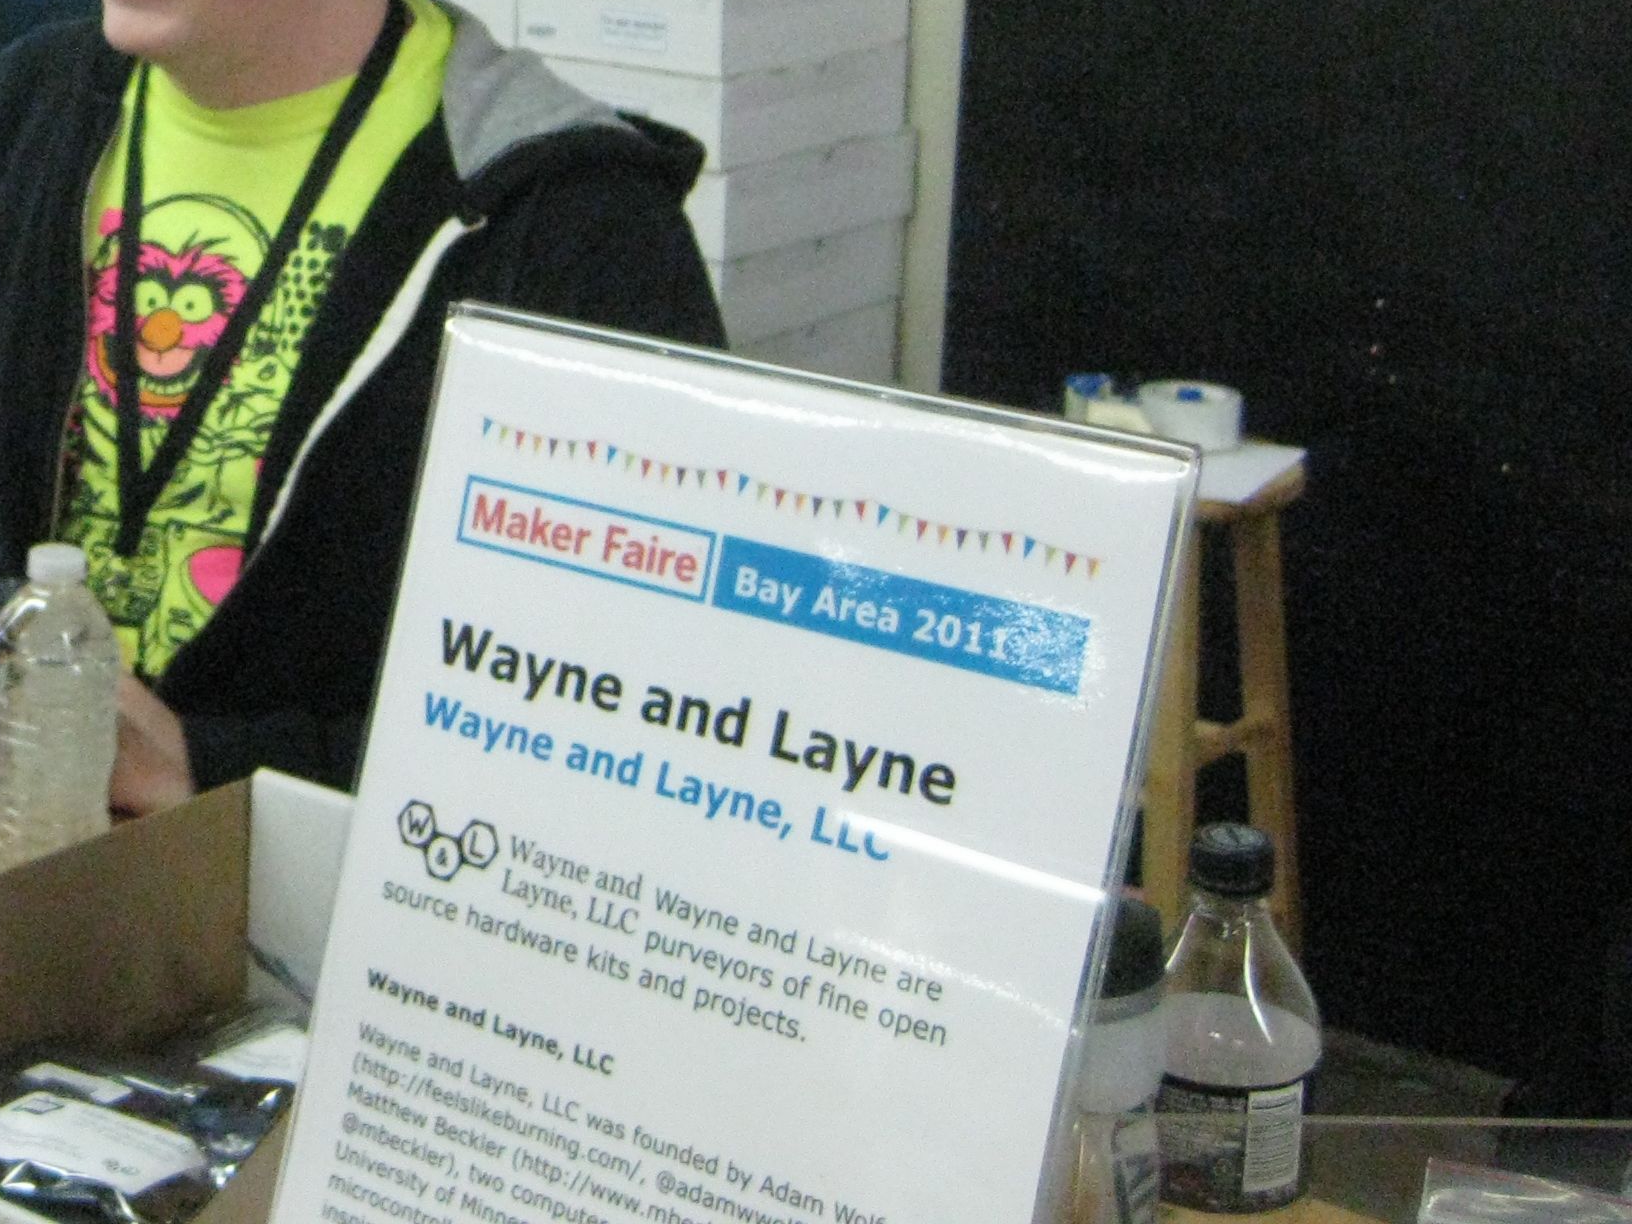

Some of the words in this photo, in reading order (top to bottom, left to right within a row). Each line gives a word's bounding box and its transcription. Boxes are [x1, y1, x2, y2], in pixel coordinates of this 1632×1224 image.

[472, 493, 591, 555] Maker
[602, 524, 698, 583] Faire
[734, 566, 802, 614] Bay
[811, 586, 900, 633] Area
[912, 609, 1010, 661] 2011
[442, 618, 622, 712] Wayne
[640, 685, 752, 747] and
[769, 709, 956, 805] Layne
[425, 691, 554, 761] Wayne
[566, 742, 644, 787] and
[655, 761, 792, 840] Layne,
[811, 806, 889, 861] LLC
[501, 868, 577, 920] Layne,
[586, 896, 639, 935] LLC
[510, 835, 590, 884] Wayne
[595, 871, 643, 901] and
[382, 881, 458, 921] source
[465, 904, 578, 963] hardware
[586, 945, 630, 981] kits
[639, 968, 687, 999] and
[693, 987, 807, 1042] projects.
[644, 930, 773, 988] purveyors
[783, 976, 812, 999] of
[818, 981, 868, 1019] fine
[878, 1008, 946, 1046] open
[656, 887, 738, 935] Wayne
[747, 923, 797, 954] and
[806, 935, 887, 983] Layne
[897, 970, 943, 1001] are
[368, 968, 439, 1011] Wayne
[445, 1001, 486, 1027] and
[493, 1015, 563, 1060] Layne,
[573, 1044, 615, 1075] LLC
[347, 1081, 428, 1129] Matthew
[359, 1022, 421, 1062] Wayne
[427, 1052, 464, 1078] and
[470, 1063, 533, 1108] Layne,
[542, 1092, 580, 1122] LLC
[586, 1112, 625, 1140] was
[633, 1126, 719, 1175] founded
[727, 1159, 752, 1192] by
[759, 1175, 824, 1216] Adam
[335, 1140, 430, 1197] University
[435, 1186, 456, 1205] of
[461, 1192, 528, 1224] Minne
[469, 1163, 504, 1192] two
[511, 1185, 608, 1224] compute
